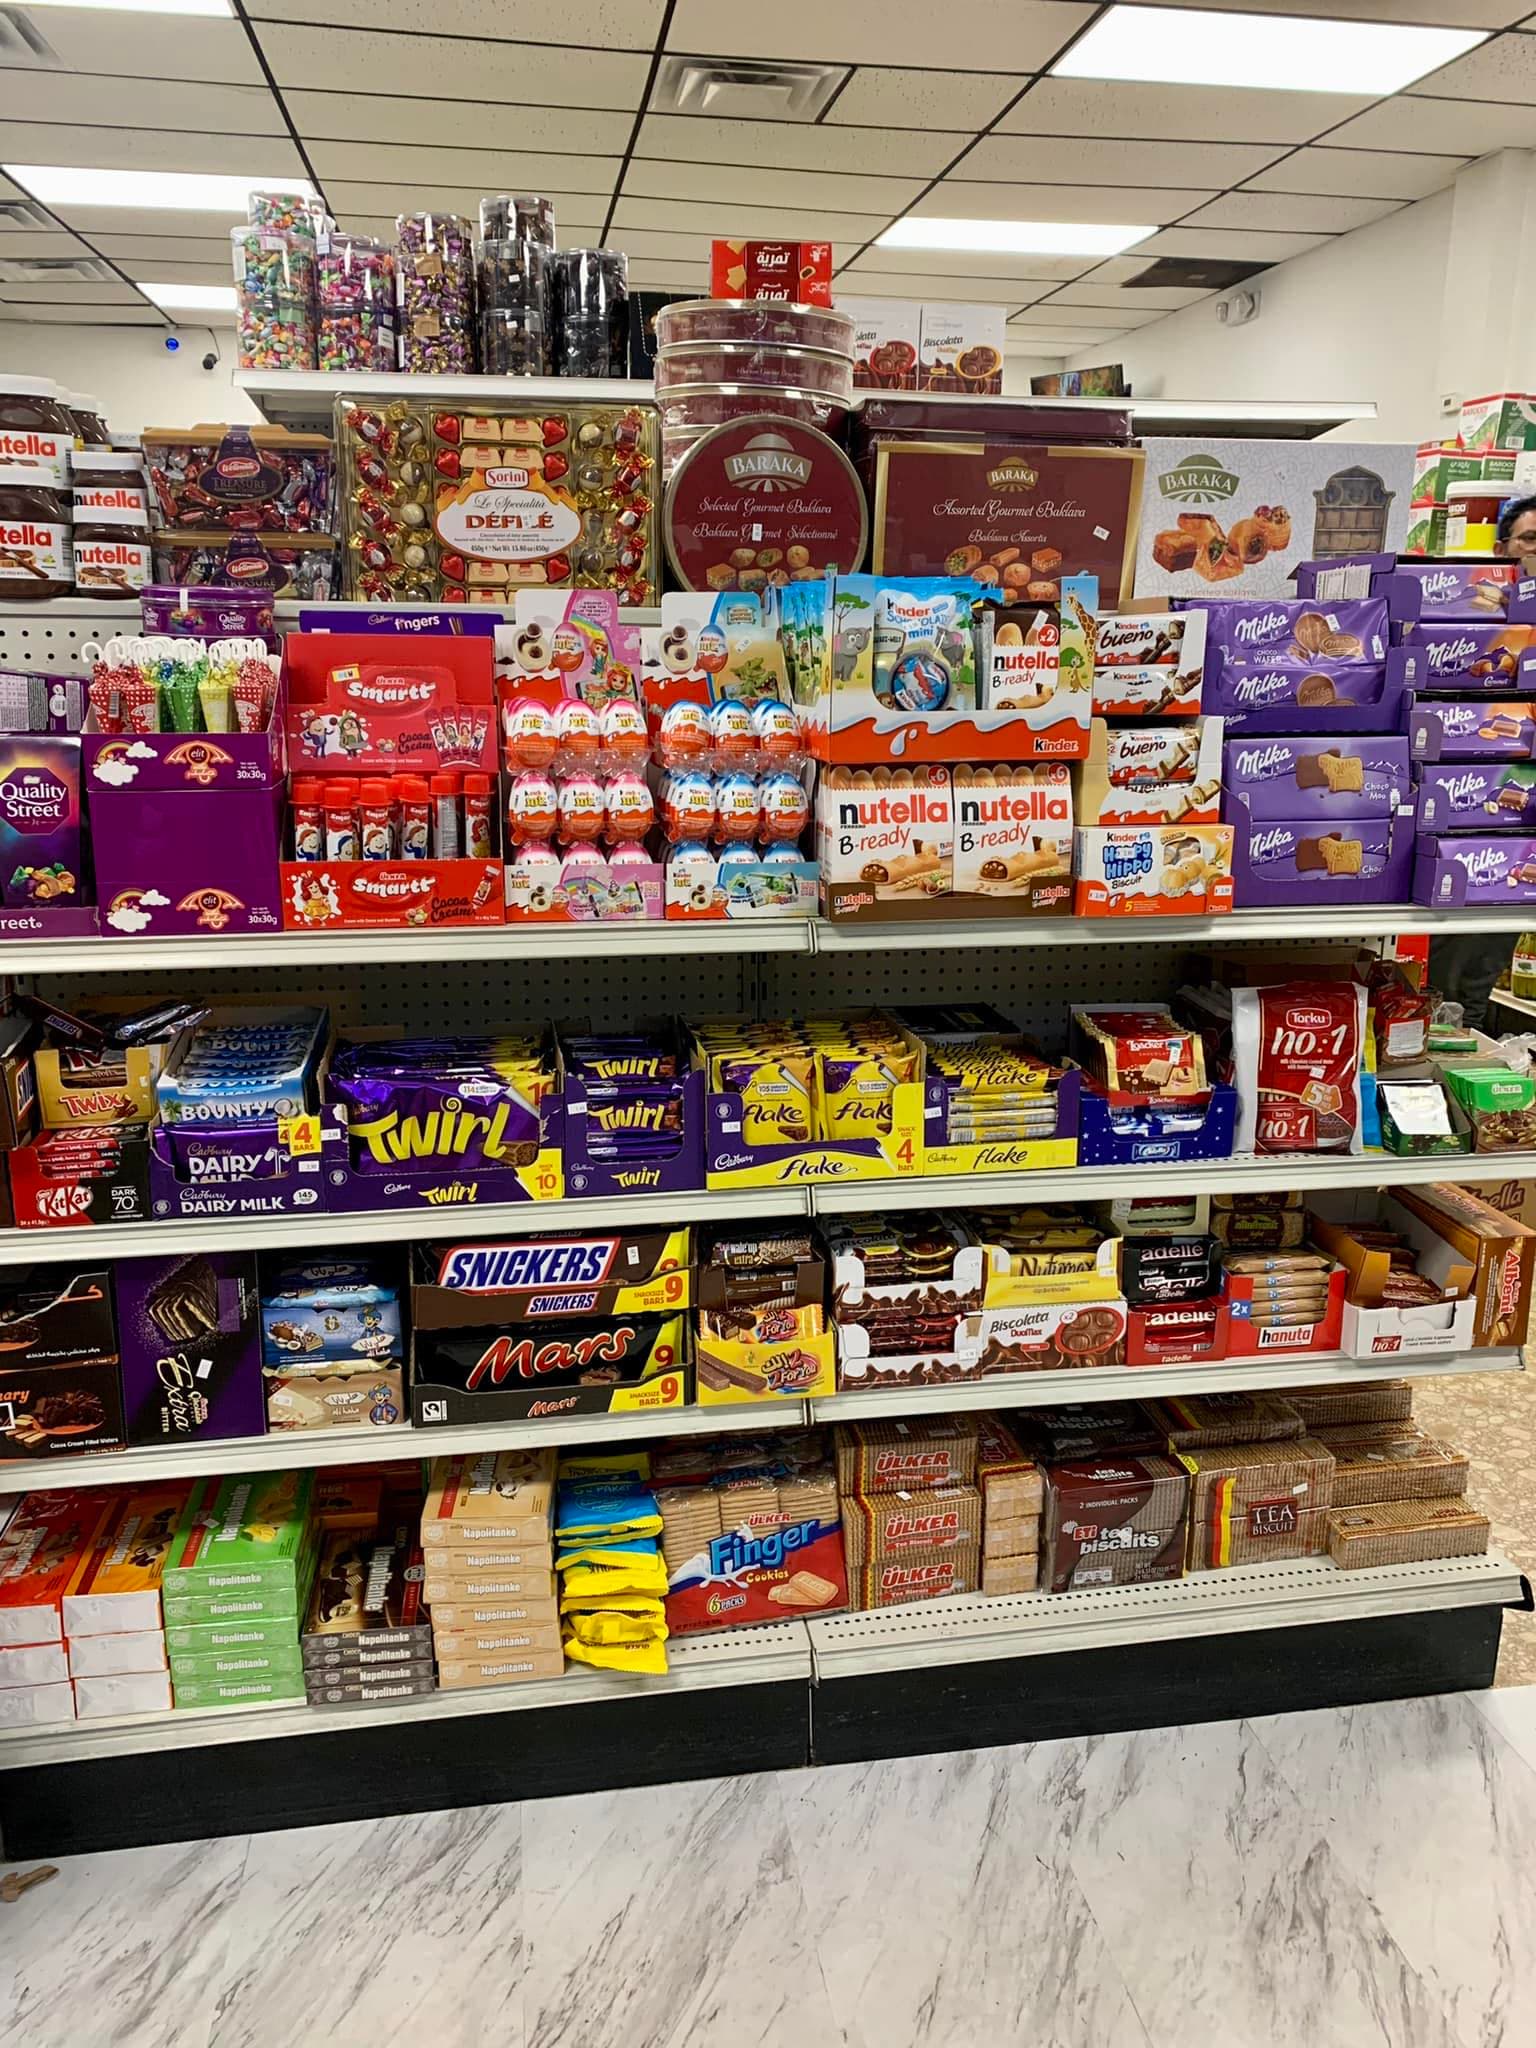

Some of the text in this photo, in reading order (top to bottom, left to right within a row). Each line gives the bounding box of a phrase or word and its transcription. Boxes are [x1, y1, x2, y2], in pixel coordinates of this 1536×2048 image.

[923, 336, 964, 348] Biscolata
[488, 470, 525, 484] Sorini
[732, 456, 805, 478] BARAKA
[991, 469, 1035, 483] BARAKA
[1164, 471, 1233, 492] BARAKA
[75, 490, 141, 508] nutella
[699, 496, 739, 513] Selected
[743, 498, 785, 517] Gourmet
[465, 511, 554, 529] DÉFIÉ
[932, 499, 1087, 523] Assorted Gourmet Baklava
[741, 523, 782, 543] Grmet
[75, 546, 142, 565] nutella
[219, 613, 246, 625] Quality
[222, 622, 245, 631] Street
[1114, 621, 1139, 630] Kinder
[1234, 611, 1290, 644] Milka
[907, 627, 934, 640] mini
[1039, 629, 1056, 642] x2
[1100, 629, 1154, 649] bueno
[994, 650, 1060, 670] nutella
[1425, 637, 1478, 666] Milka
[992, 671, 1035, 688] B-ready
[1113, 671, 1137, 680] Kinder
[1233, 671, 1290, 703] Milka
[1034, 738, 1079, 752] Kinder
[1120, 740, 1167, 759] bueno
[1236, 743, 1293, 777] Milka
[236, 770, 266, 781] 30x30g
[930, 767, 946, 783] x6
[1050, 765, 1065, 782] x6
[0, 782, 67, 803] Quality
[1364, 781, 1390, 792] Choco
[1436, 771, 1488, 801] Milka
[6, 801, 62, 818] Street
[839, 794, 948, 825] nutella
[961, 791, 1067, 823] nutella
[839, 825, 911, 856] B-ready
[960, 823, 1031, 853] B-ready
[1106, 832, 1137, 843] Kinder
[1250, 827, 1294, 857] Milka
[1103, 842, 1152, 863] HPY
[1455, 848, 1508, 878] Milka
[835, 893, 873, 906] nutella
[1033, 886, 1070, 900] nutella
[1124, 901, 1133, 912] 5
[248, 915, 278, 925] 30x30g
[1292, 1012, 1326, 1024] Torku
[1271, 1024, 1348, 1056] no:1
[584, 1056, 659, 1079] Twirl
[975, 1069, 1038, 1089] flake
[1308, 1083, 1324, 1103] 5
[59, 1092, 125, 1117] Twix
[181, 1101, 269, 1121] BOUNTY
[743, 1103, 804, 1124] flake
[588, 1100, 665, 1131] Twirl
[293, 1121, 312, 1144] 4
[348, 1096, 511, 1165] Twirl
[1258, 1115, 1310, 1138] no:1
[187, 1142, 233, 1158] Cadbury
[293, 1143, 315, 1151] BARS
[896, 1138, 916, 1164] 4
[188, 1155, 261, 1175] DAIRY
[714, 1153, 754, 1170] Cadbury
[776, 1155, 857, 1180] flake
[898, 1163, 914, 1172] bars
[973, 1145, 1029, 1170] flake
[536, 1174, 557, 1189] 10
[610, 1166, 661, 1188] Twirl
[40, 1186, 91, 1217] KitKat
[111, 1188, 137, 1197] DARK
[179, 1187, 227, 1201] Cadbury
[418, 1179, 478, 1205] Twirl
[181, 1196, 285, 1214] DAIRY MILK
[447, 1245, 609, 1289] SNICKERS
[664, 1275, 684, 1303] 9
[1500, 1249, 1521, 1315] Albeni
[530, 1293, 596, 1313] SNICKERS
[643, 1296, 665, 1306] BARS
[1231, 1302, 1249, 1316] 2x
[989, 1312, 1050, 1334] Biscolata
[1262, 1327, 1312, 1344] hanuta
[466, 1327, 635, 1391] Mars
[654, 1345, 675, 1371] 9
[781, 1367, 800, 1384] For
[800, 1361, 817, 1379] You
[156, 1352, 194, 1433] Extra
[660, 1377, 679, 1403] 9
[527, 1396, 578, 1418] Mars
[639, 1398, 660, 1406] BARS
[876, 1450, 950, 1472] ÜLKER
[1086, 1500, 1118, 1508] INDIVIDUAL
[1120, 1497, 1138, 1505] PACKS
[748, 1512, 791, 1526] ÜLKER
[1252, 1504, 1296, 1524] TEA
[463, 1527, 517, 1540] Napolitanke
[885, 1511, 959, 1538] ÜLKER
[1252, 1520, 1296, 1536] BISCUIT
[710, 1520, 820, 1576] Finger
[1080, 1532, 1160, 1555] biscuits
[466, 1554, 521, 1567] Napolitanke
[208, 1573, 262, 1587] Napolitanke
[746, 1569, 789, 1584] Cookies
[881, 1563, 954, 1589] ÜLKER
[467, 1582, 521, 1595] Napolitanke
[210, 1601, 264, 1615] Napolitanke
[708, 1593, 746, 1615] 6 PACKS
[474, 1609, 528, 1622] Napolitanke
[212, 1631, 265, 1645] Napolitanke
[477, 1636, 531, 1649] Napolitanke
[216, 1658, 270, 1672] Napolitanke
[481, 1662, 534, 1676] Napolitanke
[219, 1684, 272, 1698] Napolitanke
